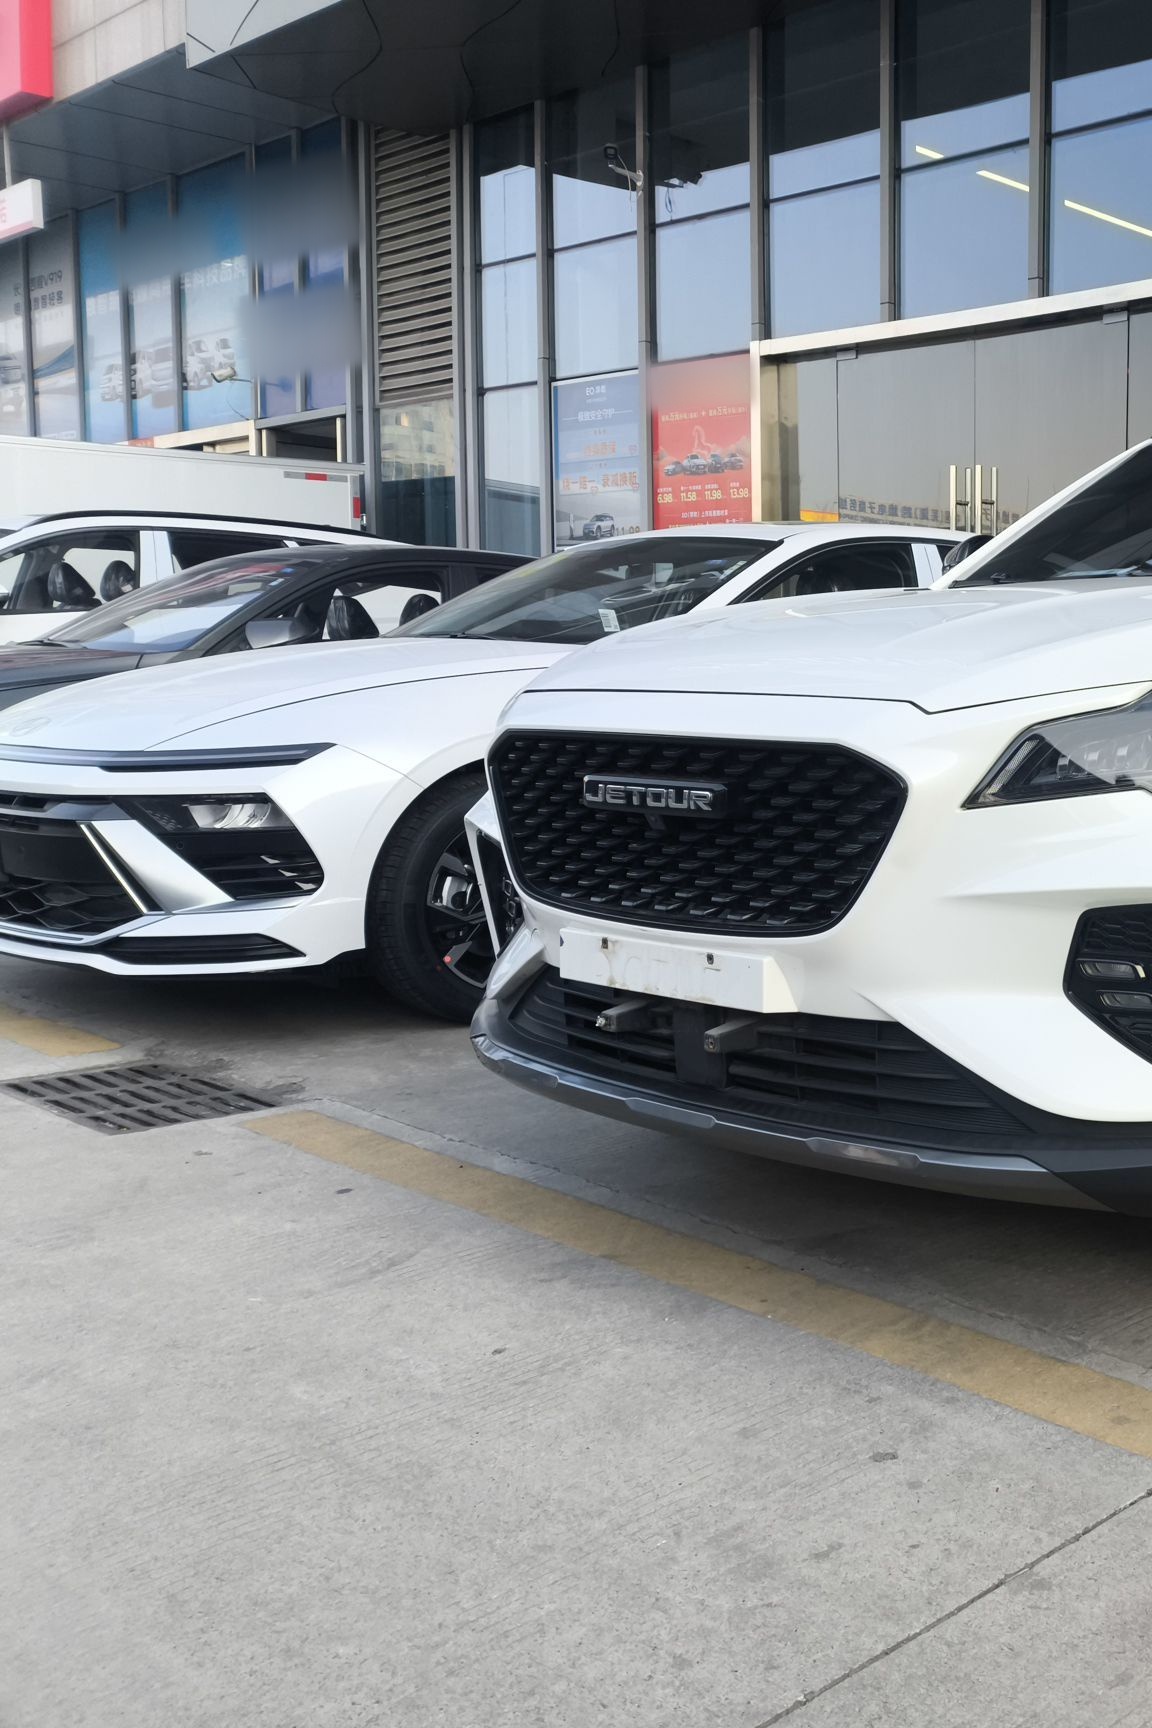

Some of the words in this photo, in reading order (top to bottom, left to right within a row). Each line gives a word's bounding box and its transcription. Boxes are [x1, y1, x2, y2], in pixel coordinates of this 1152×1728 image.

[704, 489, 722, 500] 11.98
[729, 487, 749, 498] 13.98
[585, 784, 713, 811] JETOUR
